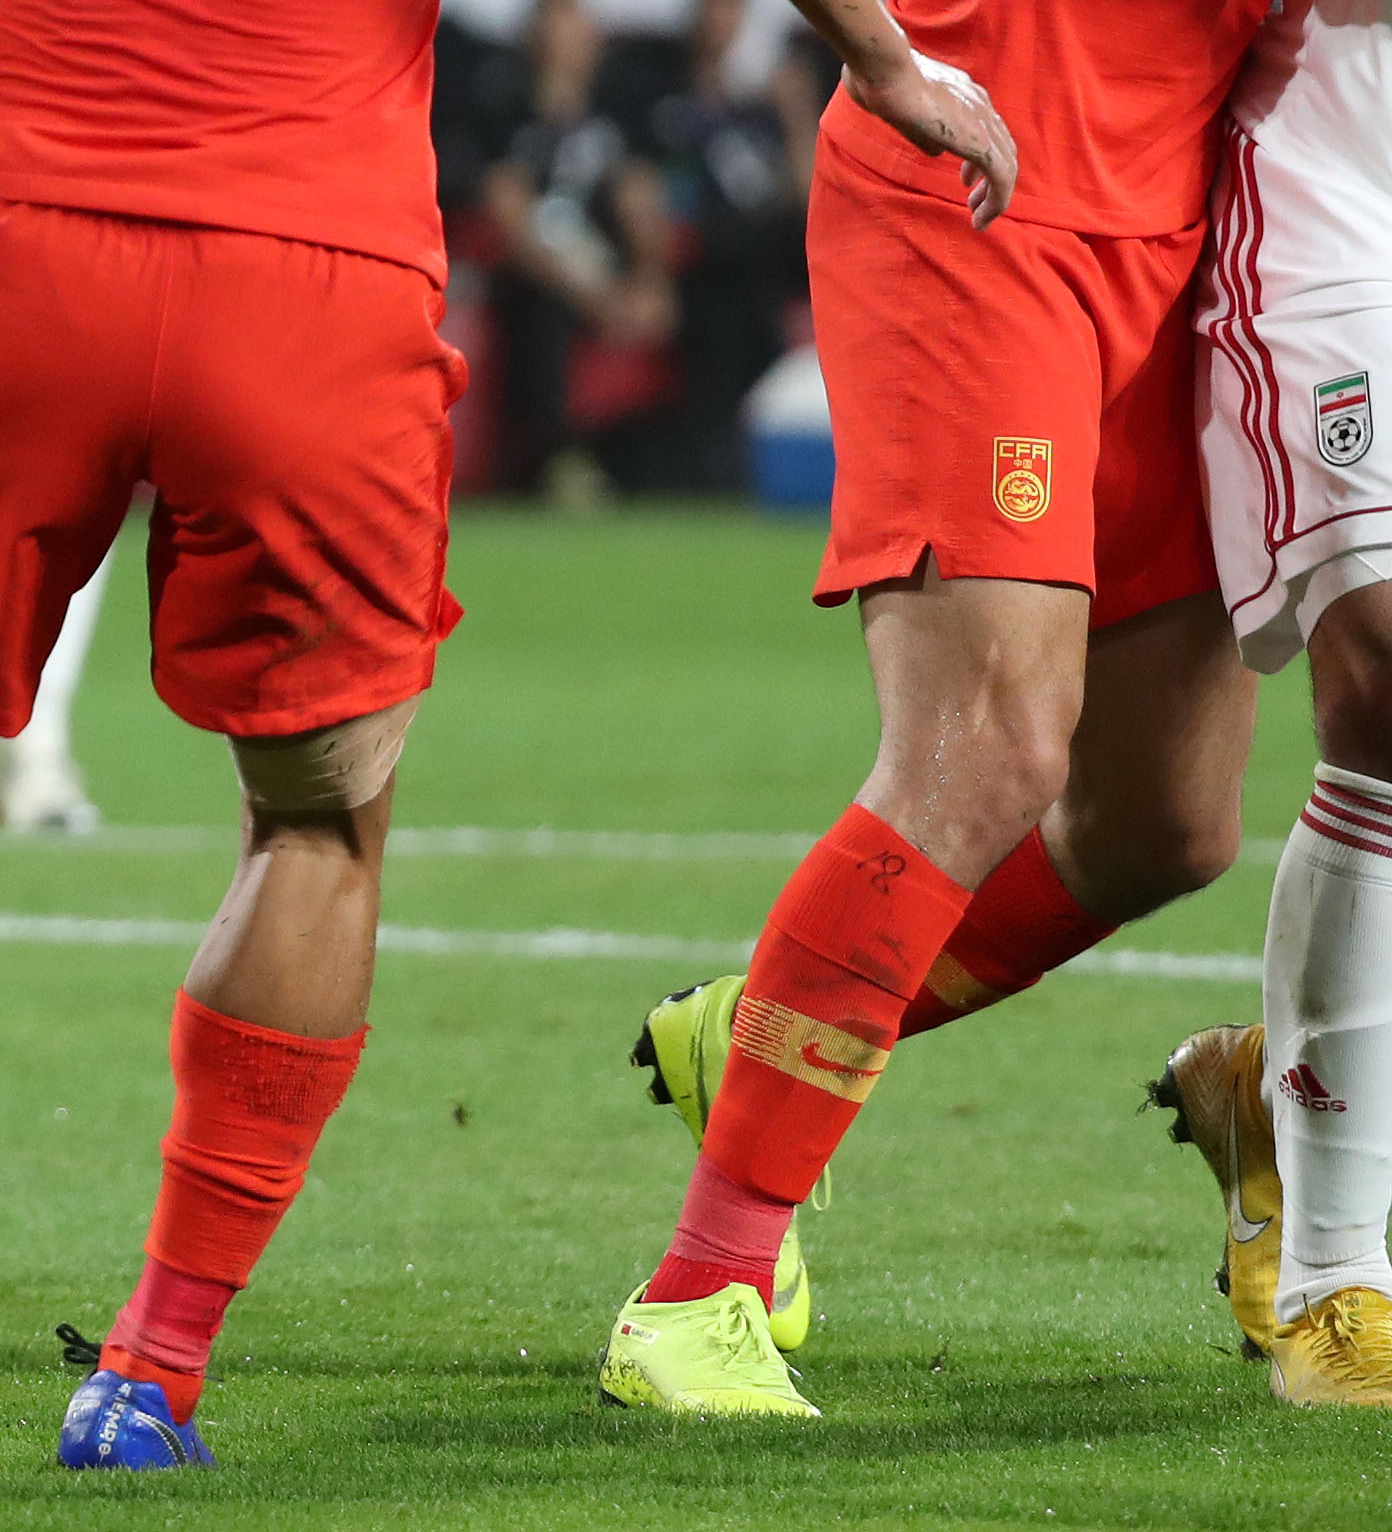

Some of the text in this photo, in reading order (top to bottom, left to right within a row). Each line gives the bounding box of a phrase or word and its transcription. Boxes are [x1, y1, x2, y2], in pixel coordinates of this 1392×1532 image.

[999, 442, 1048, 461] CFA
[1278, 1080, 1348, 1112] adidas
[97, 1382, 133, 1456] TIEMPO
